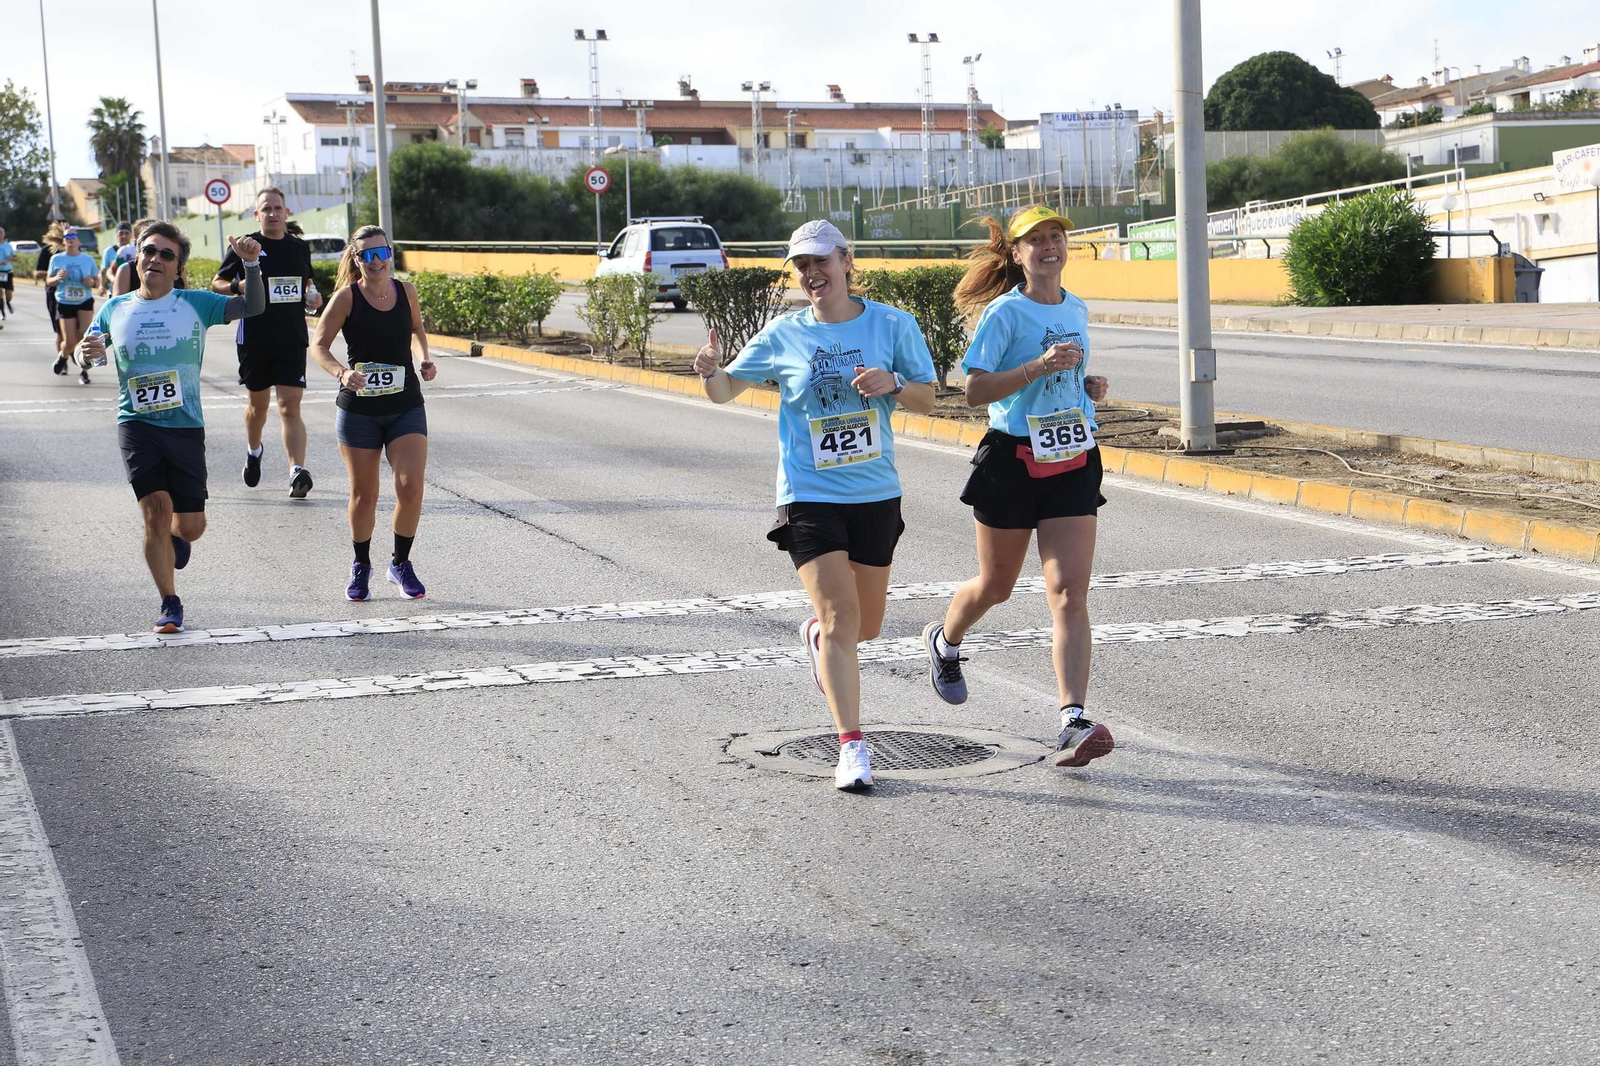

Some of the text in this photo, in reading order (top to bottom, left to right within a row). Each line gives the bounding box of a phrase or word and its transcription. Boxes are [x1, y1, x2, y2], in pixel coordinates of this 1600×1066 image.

[1061, 112, 1124, 121] MUEBES BENTO
[591, 176, 605, 185] 50
[211, 187, 226, 197] 50
[274, 285, 299, 295] 464
[835, 353, 864, 368] URBANA
[367, 372, 394, 387] 49
[136, 383, 176, 403] 278
[820, 426, 873, 453] 421
[1038, 423, 1088, 449] 369
